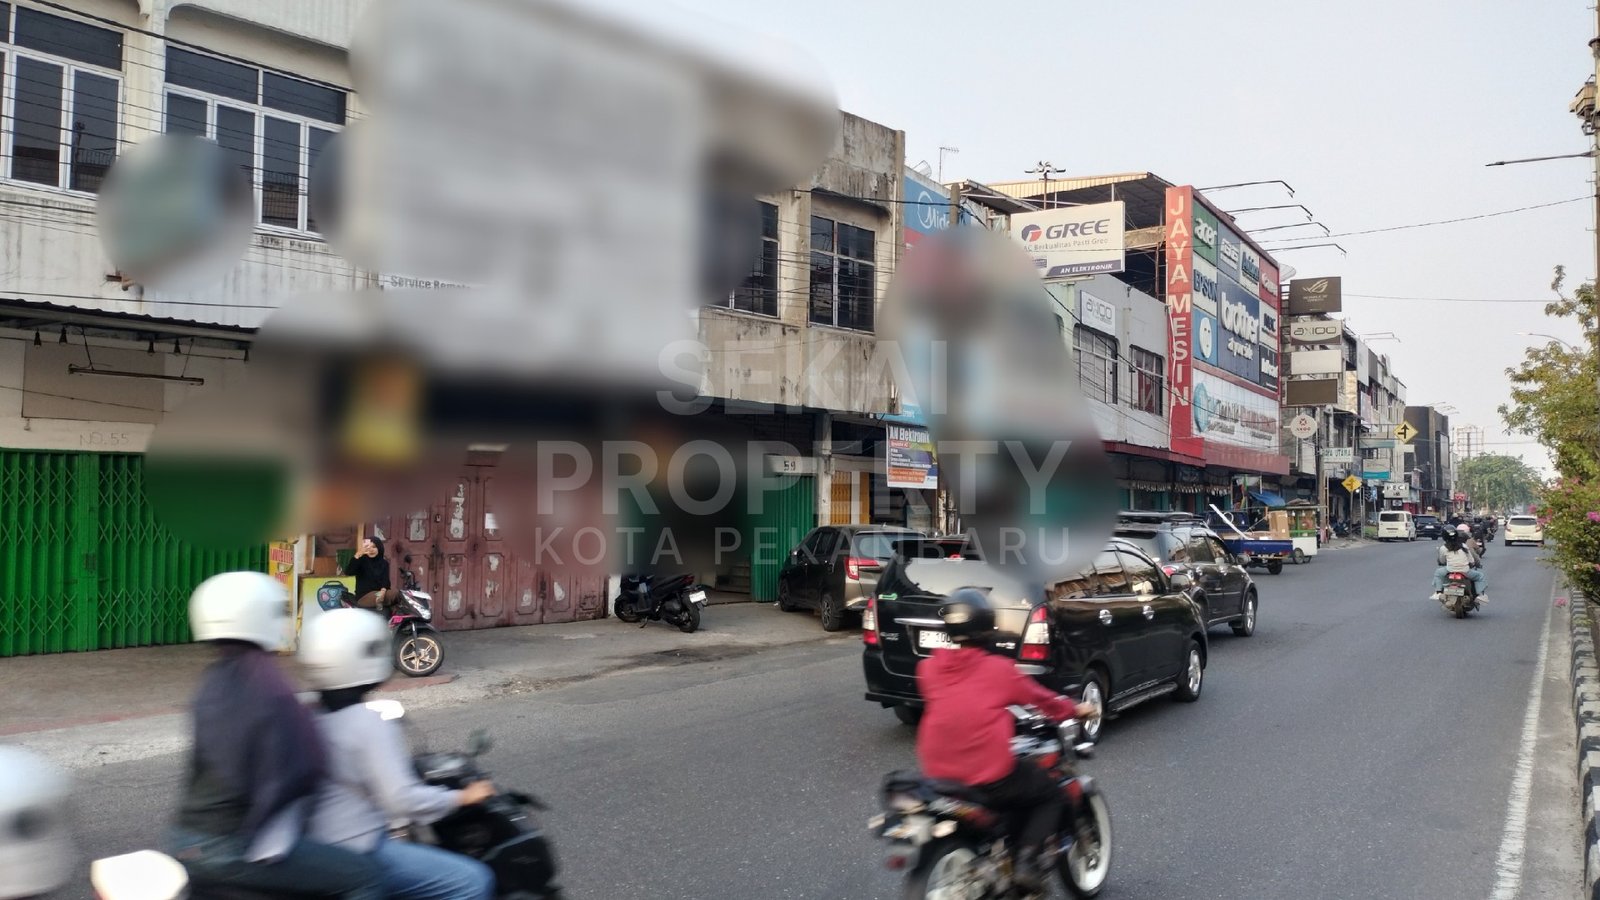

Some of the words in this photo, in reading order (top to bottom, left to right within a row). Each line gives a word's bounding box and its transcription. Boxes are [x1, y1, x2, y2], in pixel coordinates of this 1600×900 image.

[1046, 219, 1110, 239] GREE
[1170, 195, 1189, 285] JAYA
[1072, 263, 1113, 273] ELEKTRONIK
[390, 275, 432, 289] Service
[1168, 293, 1191, 406] MESIN
[783, 460, 796, 471] 59
